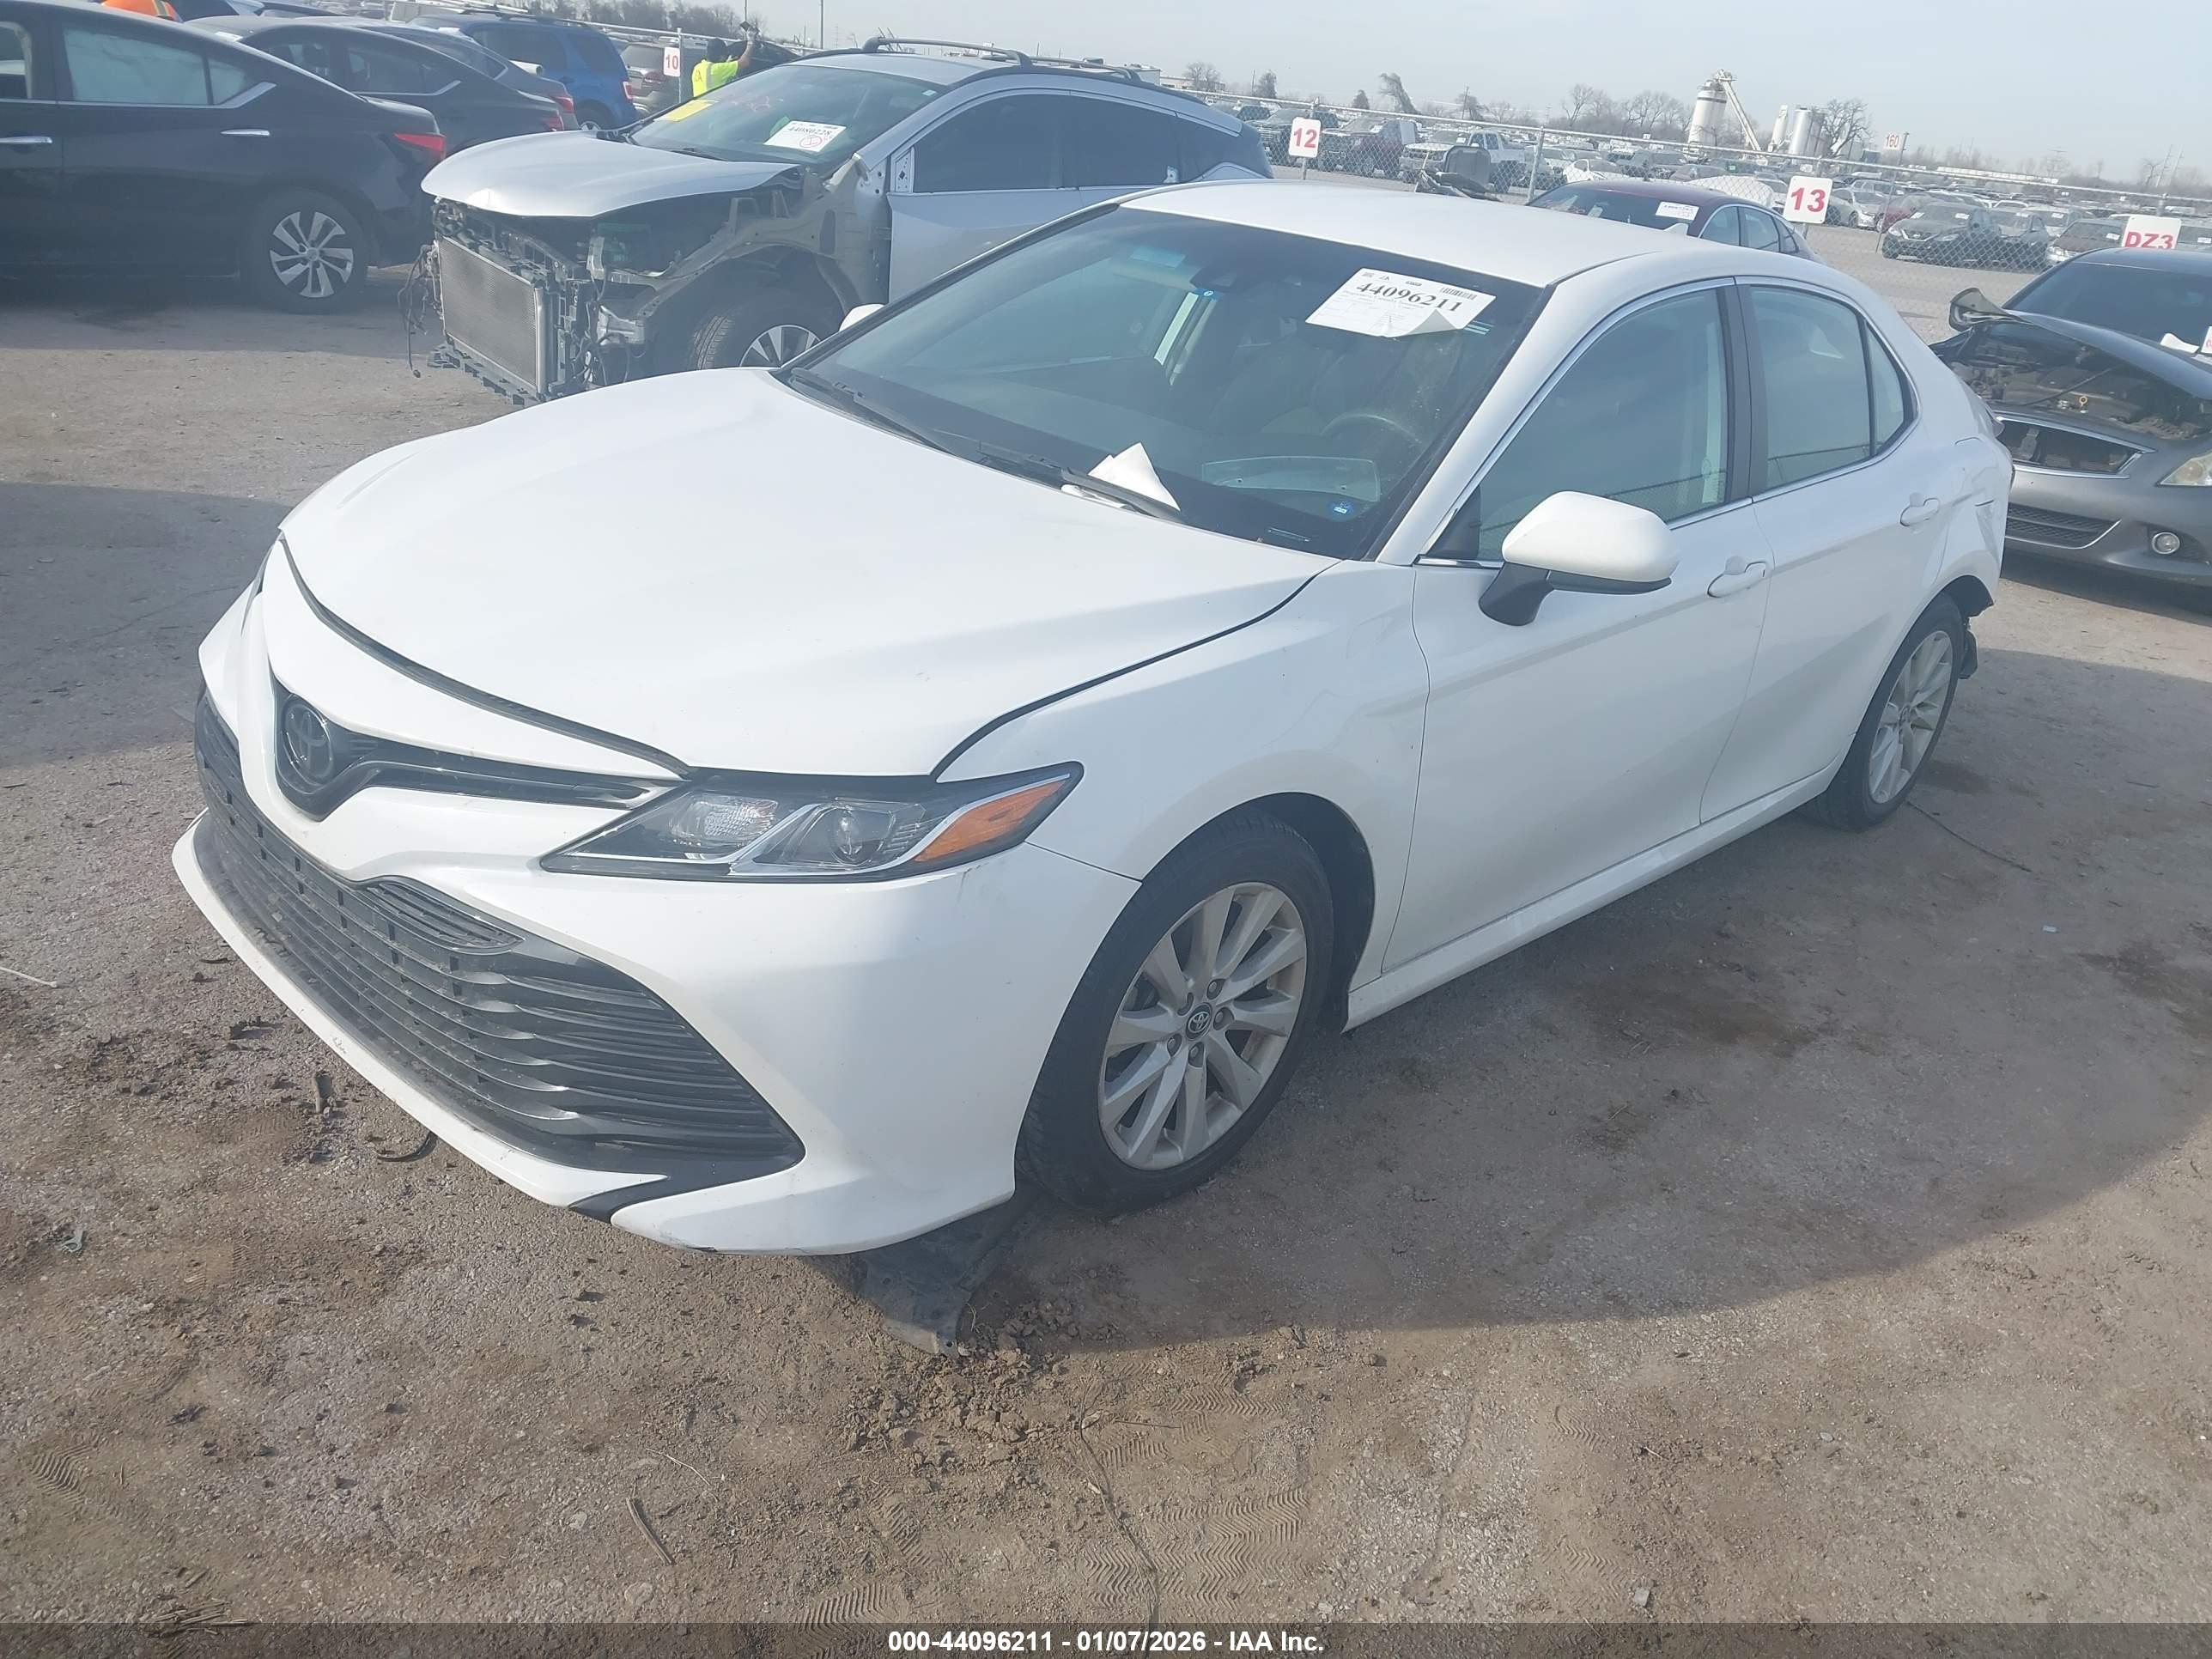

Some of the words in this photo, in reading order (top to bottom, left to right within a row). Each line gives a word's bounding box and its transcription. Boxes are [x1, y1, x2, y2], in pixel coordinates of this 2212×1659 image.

[665, 55, 678, 70] 10
[1293, 127, 1317, 148] 12
[1790, 187, 1826, 212] 13
[2124, 231, 2173, 249] DZ3
[1356, 283, 1462, 311] 44096211
